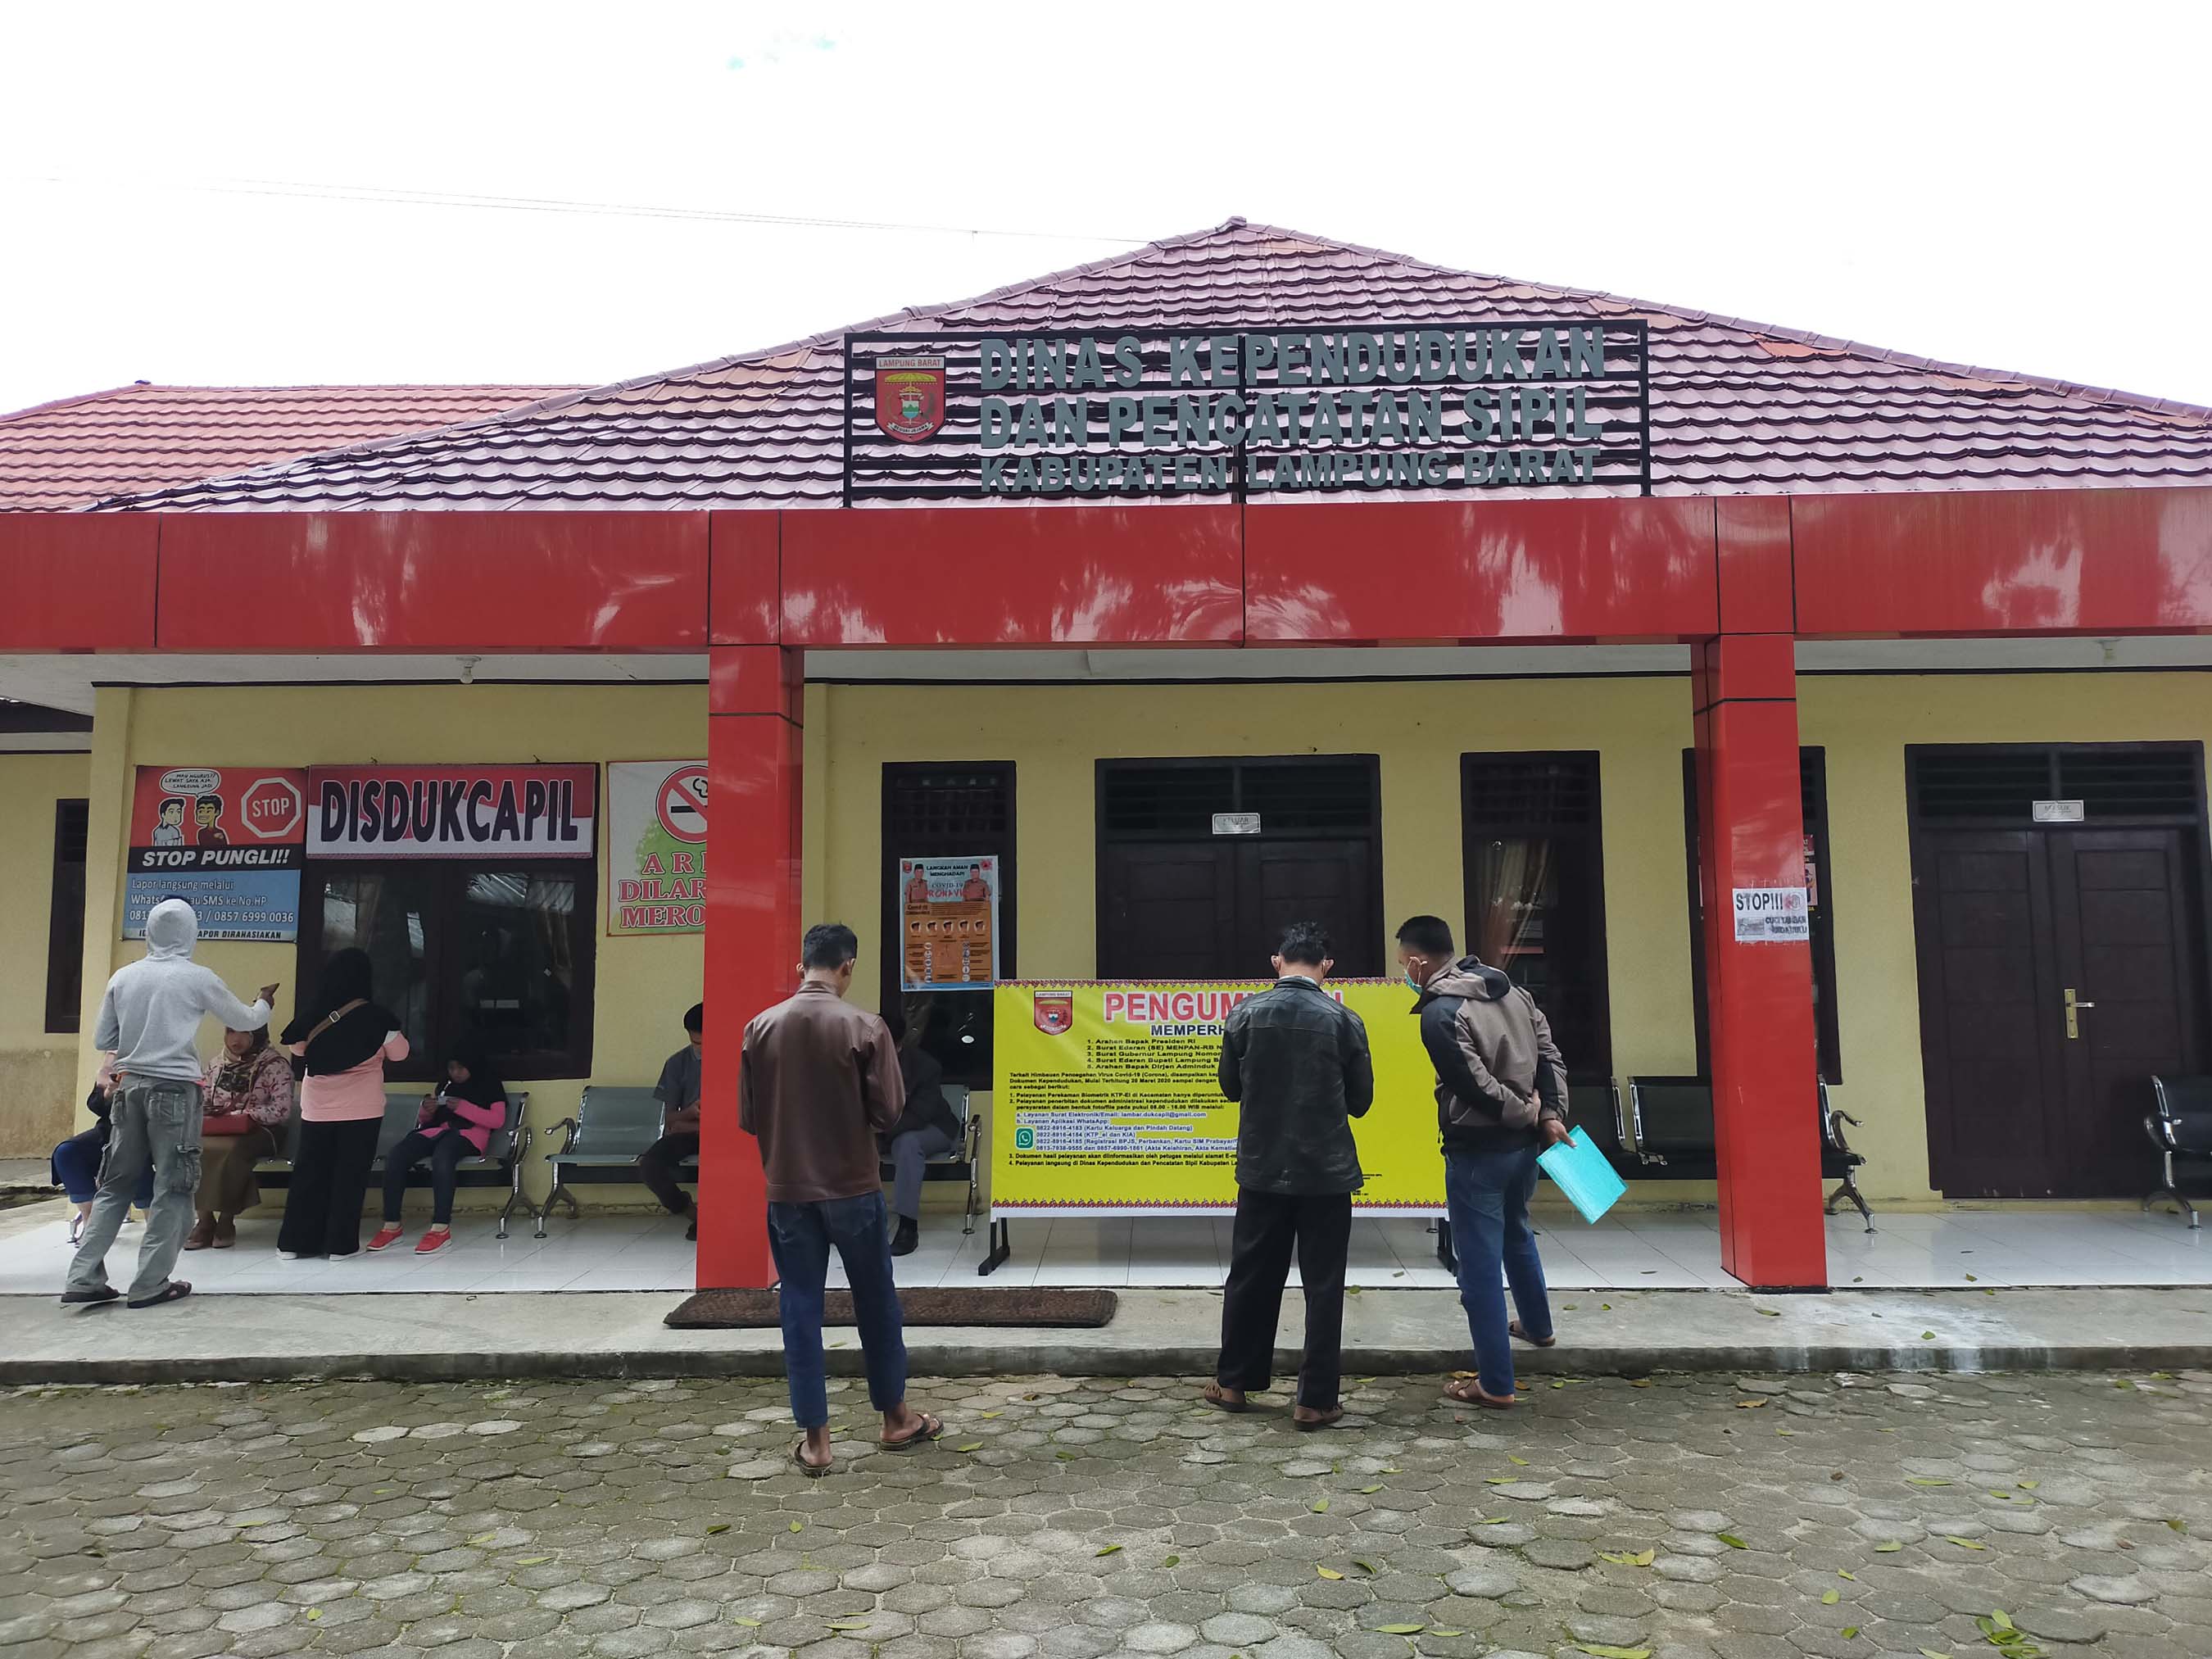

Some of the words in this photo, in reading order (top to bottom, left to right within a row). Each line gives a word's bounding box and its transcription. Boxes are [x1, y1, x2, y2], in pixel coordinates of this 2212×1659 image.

[981, 336, 1144, 390] DINAS
[1169, 327, 1605, 388] KEPENDUDUKAN
[981, 397, 1087, 449] DAN
[1108, 391, 1442, 448] PENCATATAN
[1462, 387, 1602, 442] SIPIL
[981, 454, 1227, 492] KABUPATEN
[1247, 450, 1448, 489] LAMPUNG
[1463, 447, 1601, 485] BARAT
[252, 798, 289, 818] STOP
[320, 779, 578, 842] DISDUKCAPIL
[142, 850, 197, 867] STOP
[201, 849, 290, 865] PUNGLI!!
[132, 879, 156, 890] Lapor
[159, 878, 198, 891] langsung
[201, 879, 233, 890] melalui
[619, 878, 707, 901] DILAR
[203, 895, 223, 905] SMS
[226, 895, 236, 905] ke
[238, 896, 267, 906] No.HP
[214, 911, 238, 922] 0857
[242, 912, 266, 922] 6999
[269, 912, 293, 922] 0036
[620, 904, 707, 928] MERO
[222, 931, 281, 939] DIRAHASIAKAN
[1105, 992, 1254, 1022] PENGUM
[1151, 1024, 1225, 1036] MEMPERH
